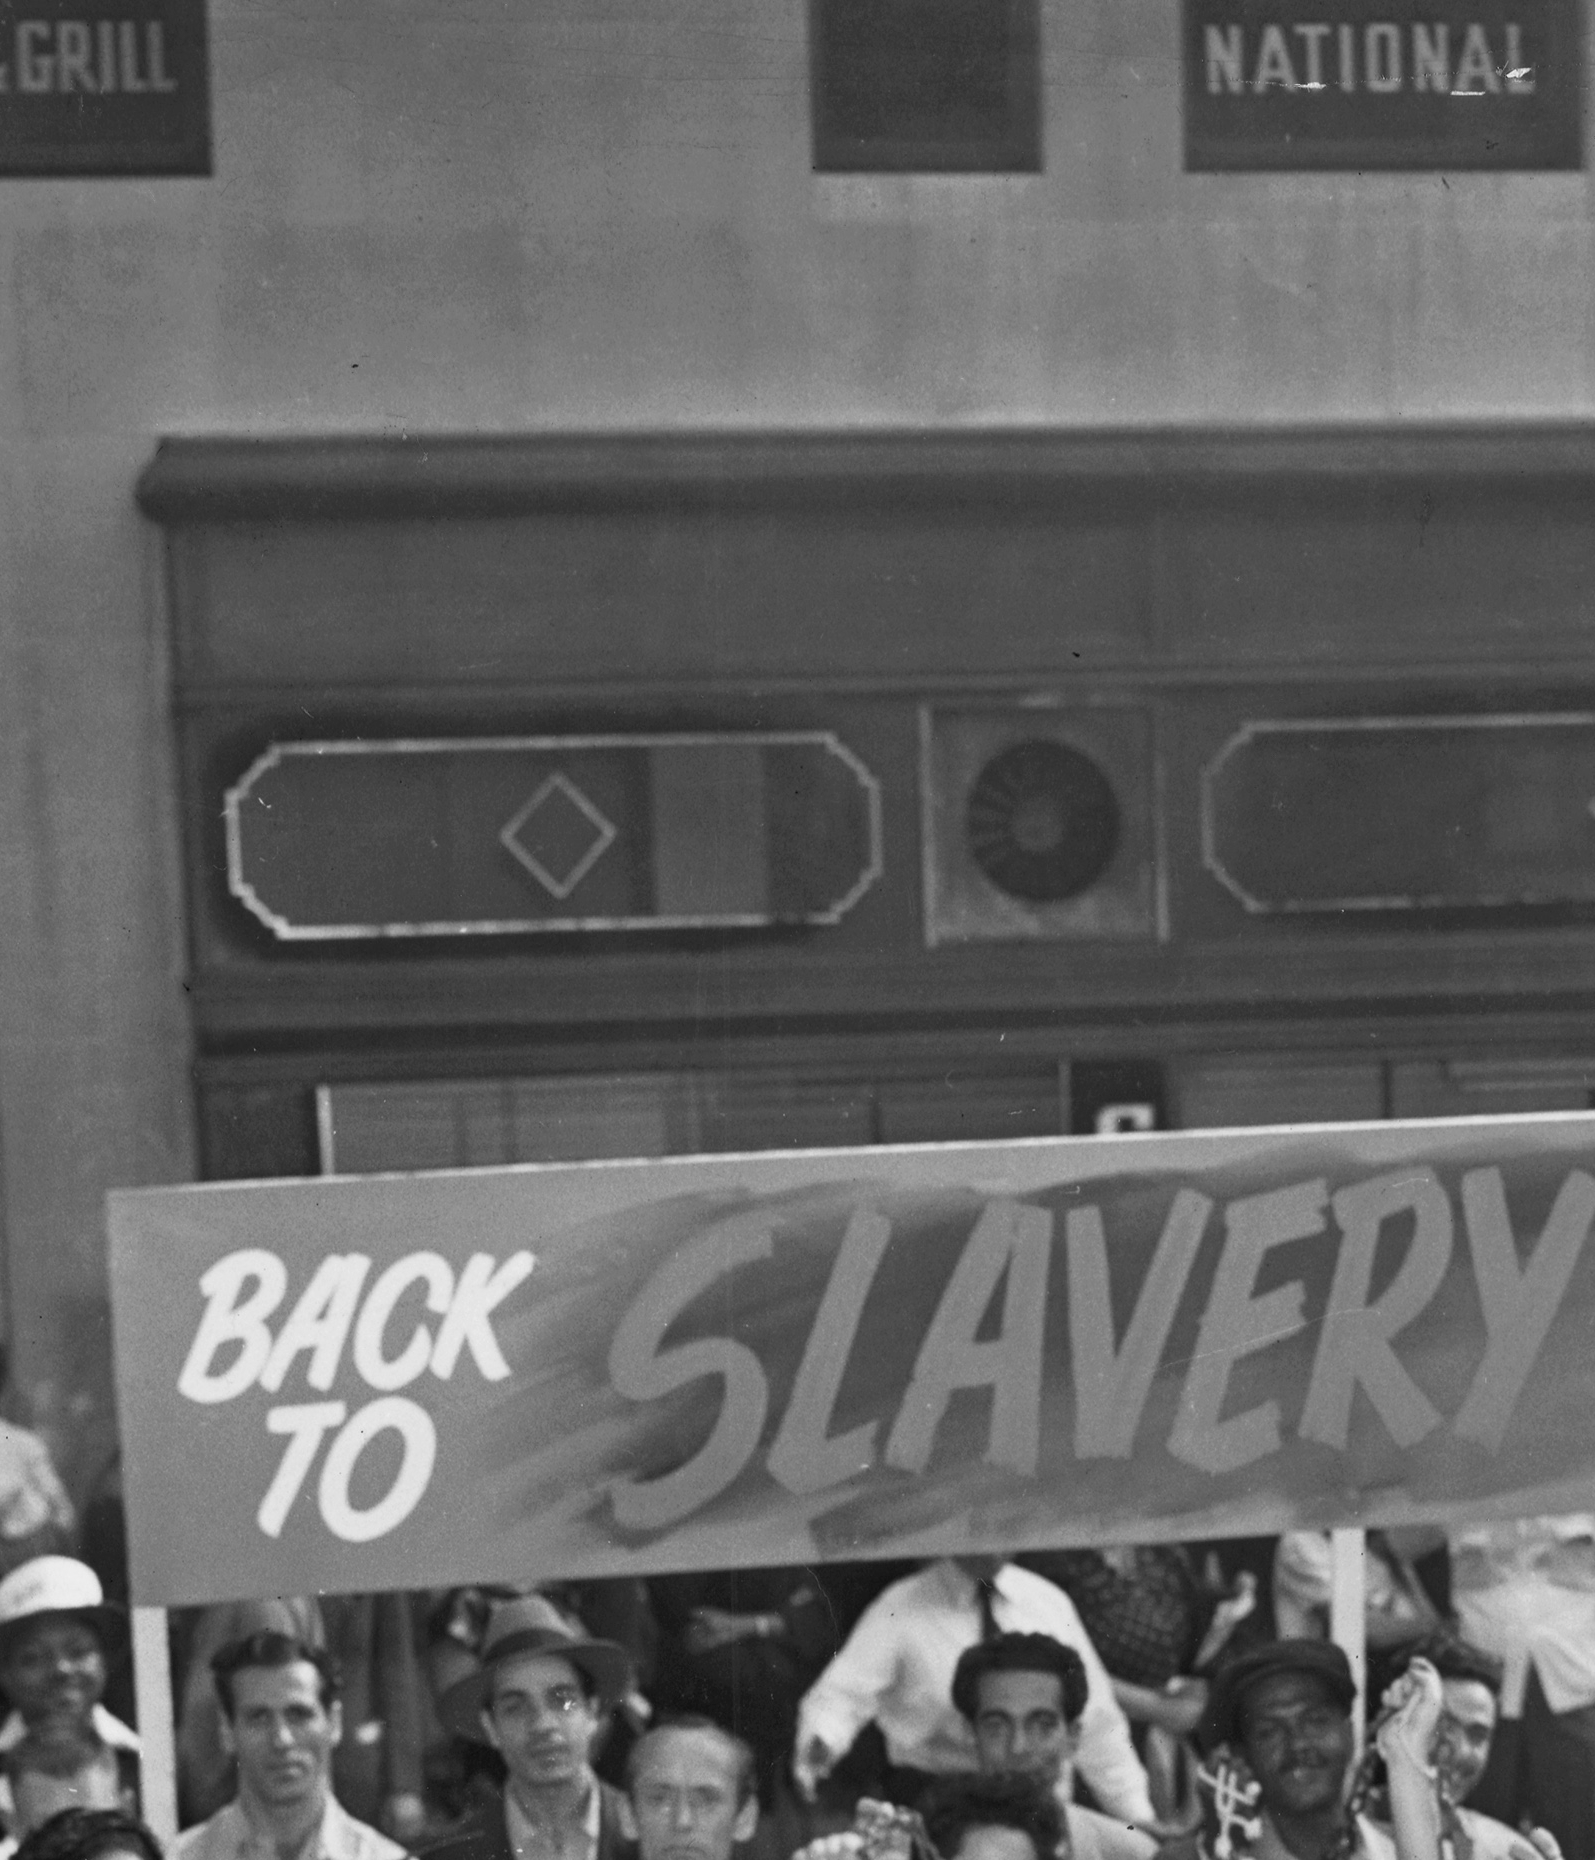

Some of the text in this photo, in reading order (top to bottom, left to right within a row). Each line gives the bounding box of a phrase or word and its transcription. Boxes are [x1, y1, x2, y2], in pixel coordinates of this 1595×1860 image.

[14, 20, 179, 94] GRILL
[1206, 22, 1537, 95] NATIONAL
[176, 1248, 537, 1404] BACK
[257, 1396, 437, 1542] TO
